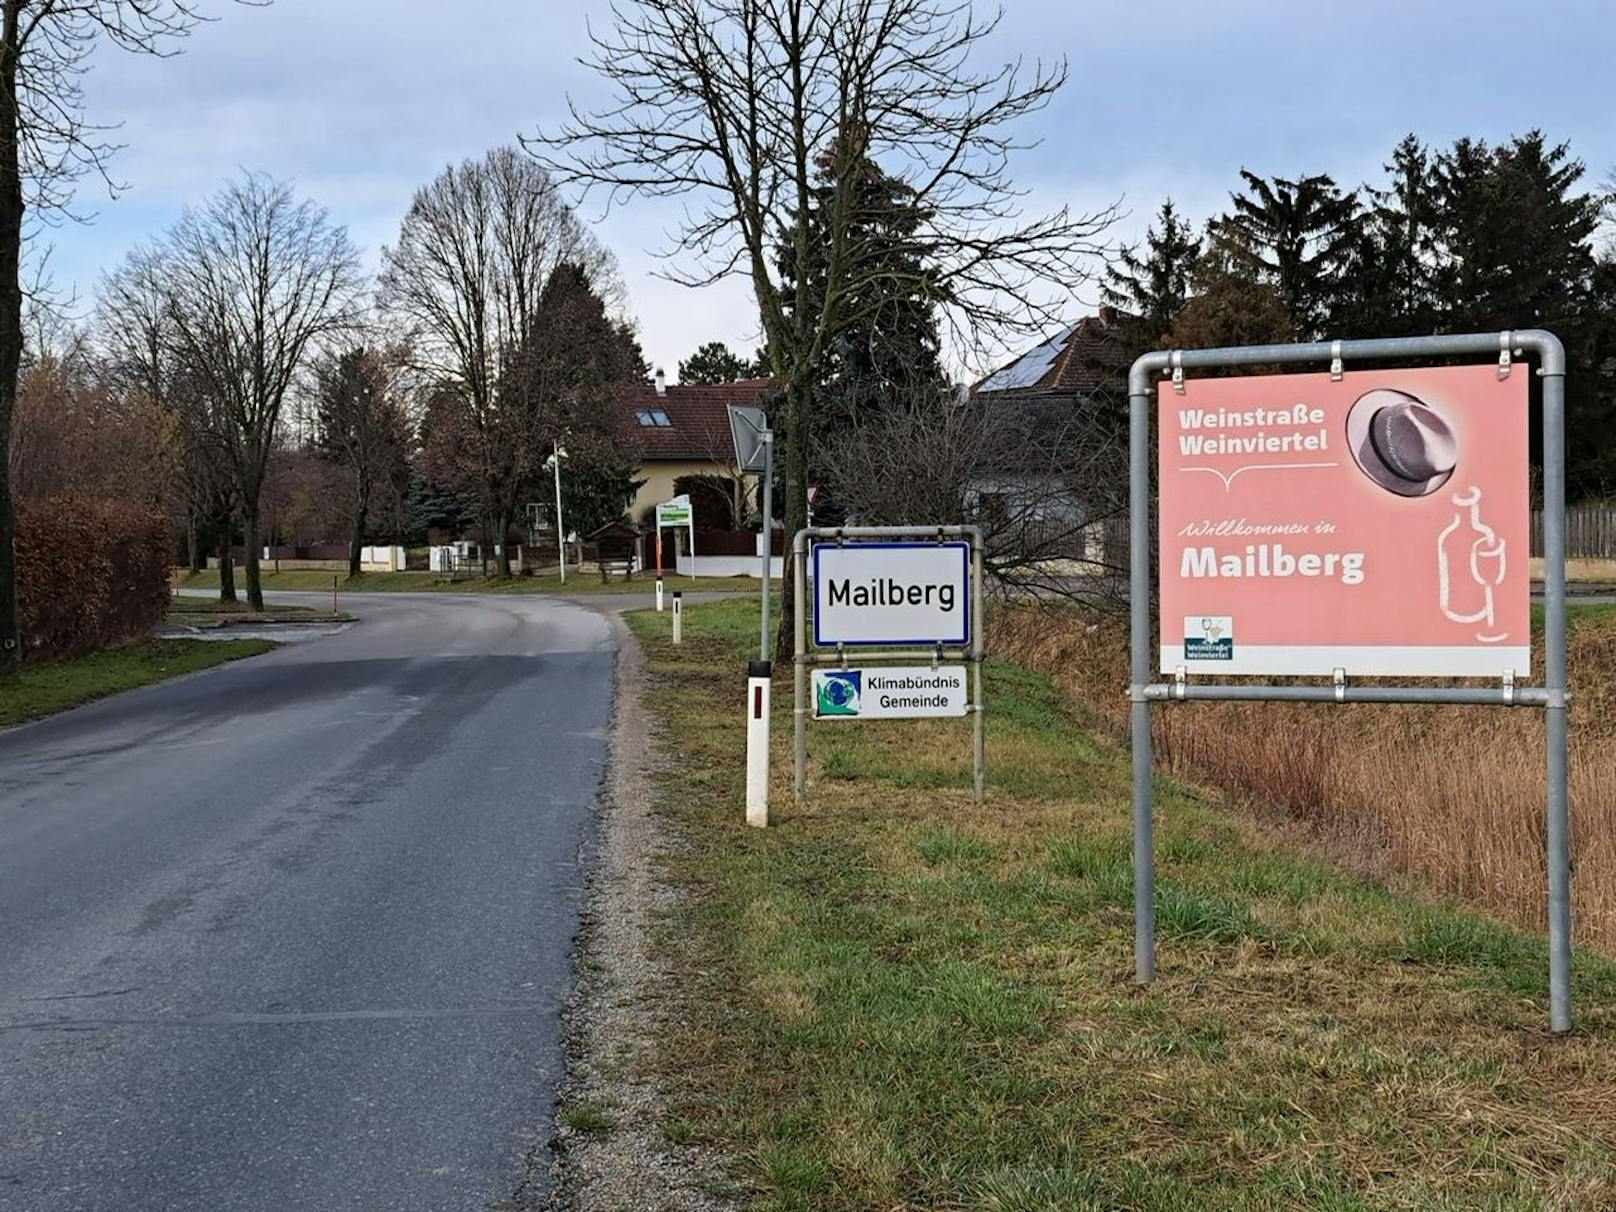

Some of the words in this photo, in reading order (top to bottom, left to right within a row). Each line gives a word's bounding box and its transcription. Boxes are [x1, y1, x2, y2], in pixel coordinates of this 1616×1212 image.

[1178, 403, 1325, 430] Weinstraße
[1178, 429, 1328, 456] Weinviertel
[1178, 518, 1309, 537] Willkommen
[1314, 520, 1337, 534] in
[1180, 544, 1365, 585] Mailberg
[828, 578, 955, 612] Mailberg
[868, 676, 960, 690] Klimabündnis
[879, 694, 949, 708] Gemeinde
